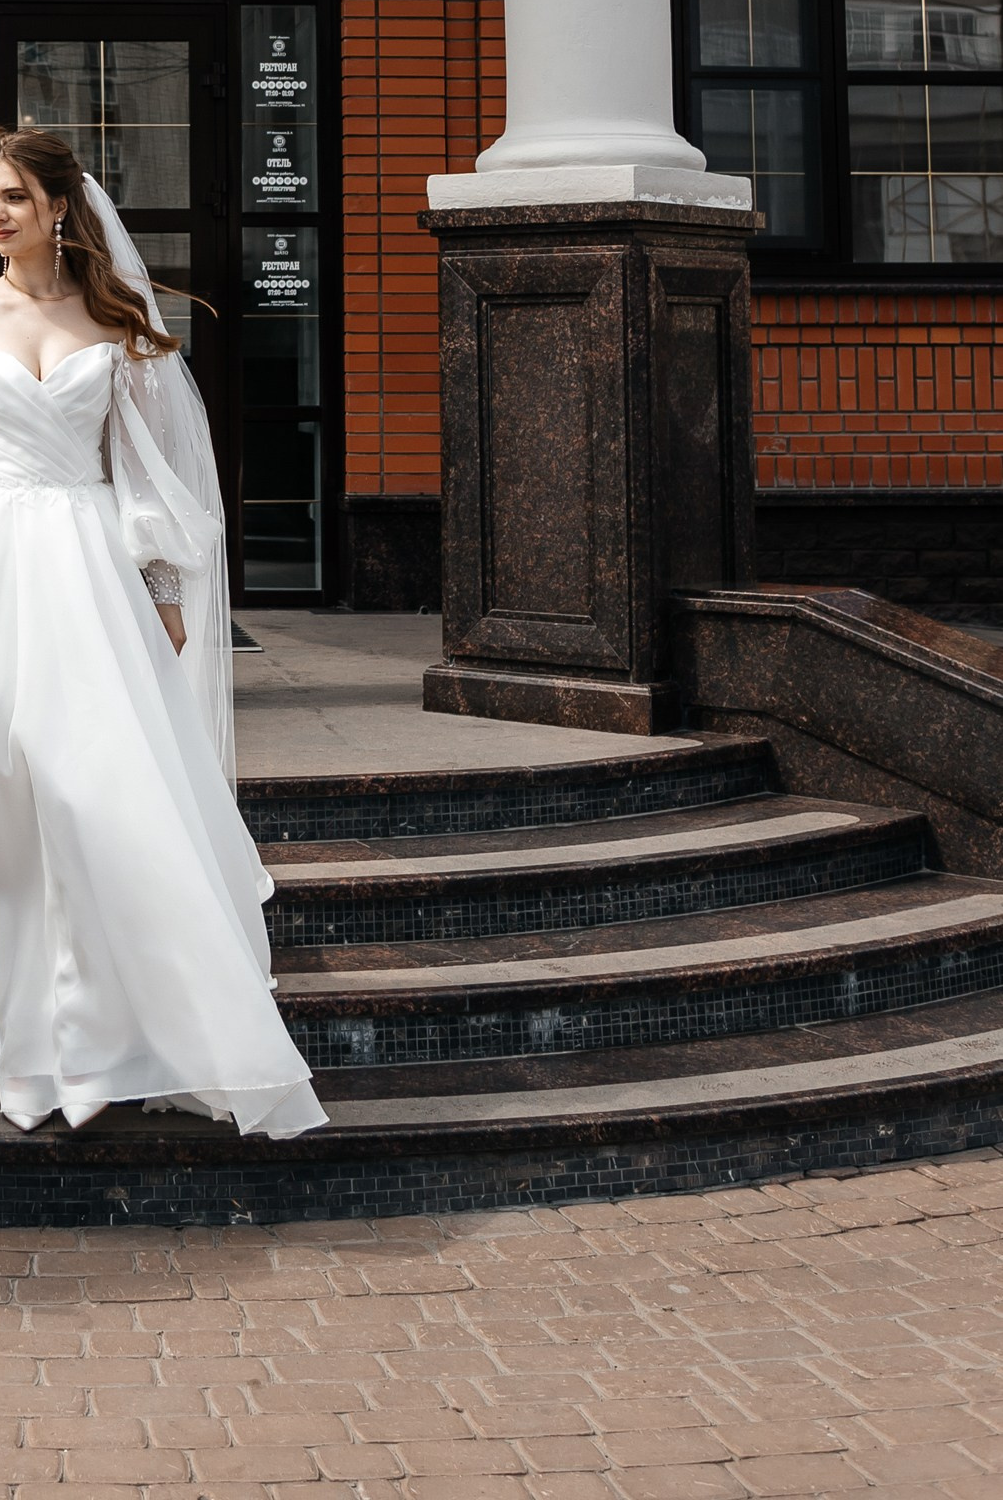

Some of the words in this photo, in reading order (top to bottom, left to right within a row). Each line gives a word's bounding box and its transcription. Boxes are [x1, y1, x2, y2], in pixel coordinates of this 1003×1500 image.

[260, 63, 297, 72] РЕСТОРАН
[267, 158, 291, 168] ОТЕЛЬ
[262, 261, 300, 271] РЕСТОРАН
